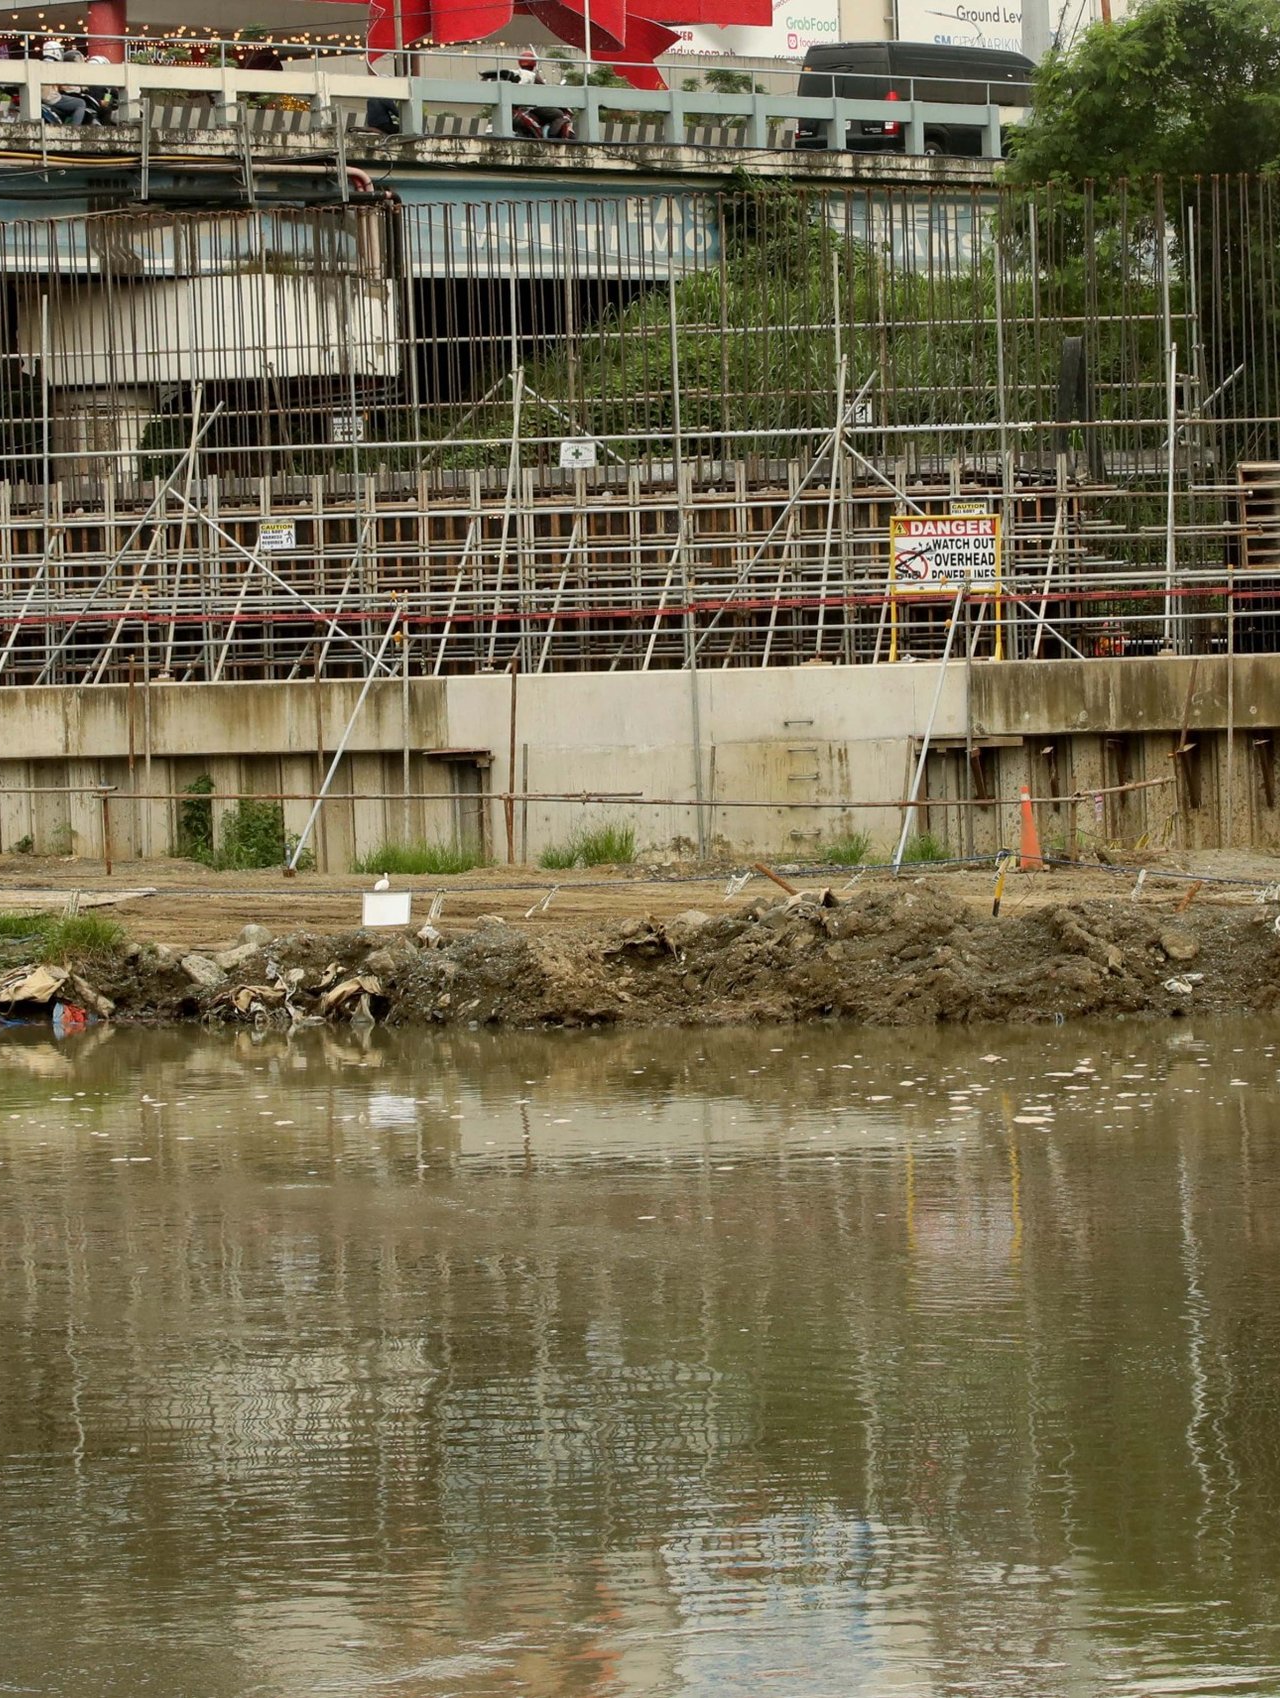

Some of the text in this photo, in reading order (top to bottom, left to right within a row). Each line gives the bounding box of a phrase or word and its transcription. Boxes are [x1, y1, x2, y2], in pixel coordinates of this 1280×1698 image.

[956, 5, 1022, 23] Ground Lev
[786, 16, 837, 32] GrabFood
[934, 35, 951, 45] SM
[978, 37, 1022, 51] MARIKIN
[910, 520, 993, 535] DANGER
[932, 538, 996, 550] WATCH OUT
[934, 552, 996, 567] OVERHEAD
